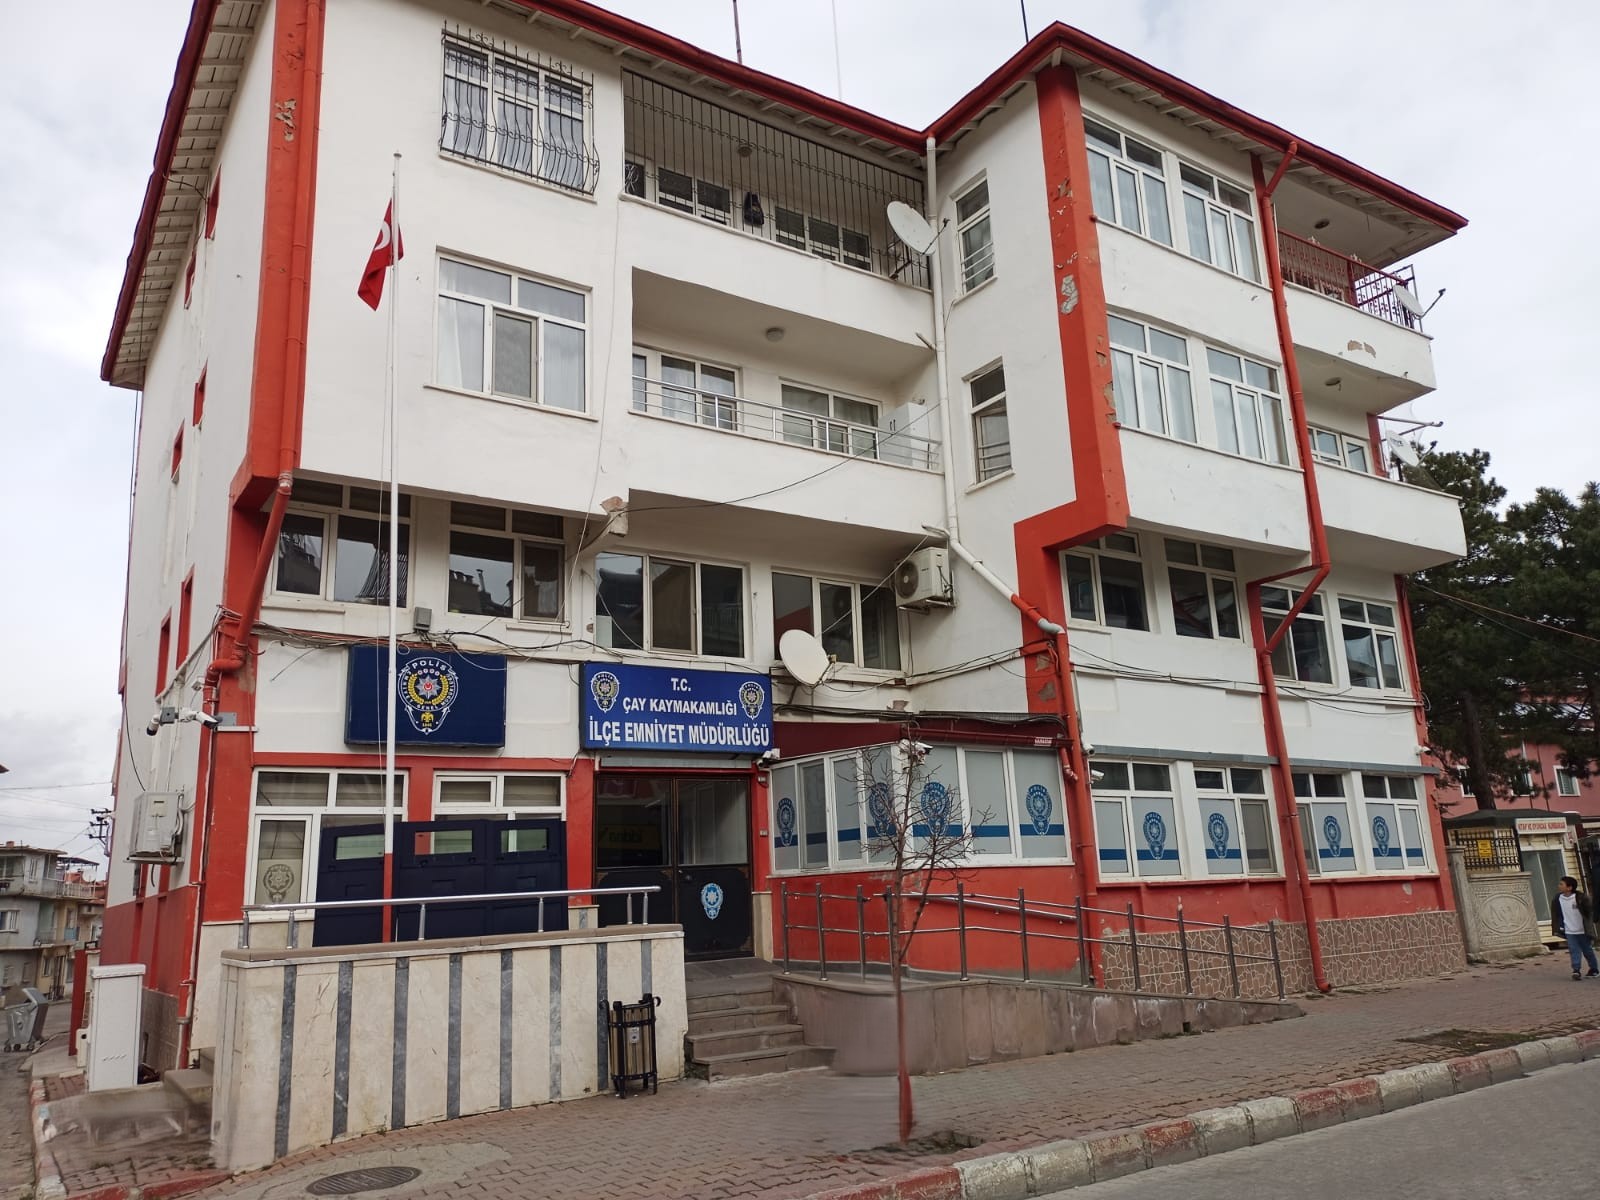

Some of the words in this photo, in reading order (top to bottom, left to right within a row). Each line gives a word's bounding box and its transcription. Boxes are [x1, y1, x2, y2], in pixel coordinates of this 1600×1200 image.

[671, 678, 691, 691] T.C.
[623, 697, 646, 713] ÇAY
[650, 700, 737, 715] KAYMAKAMLIĞI
[589, 716, 620, 746] İLÇE
[625, 719, 684, 743] EMNİYET
[688, 721, 769, 746] MÜDÜRLÜĞÜ
